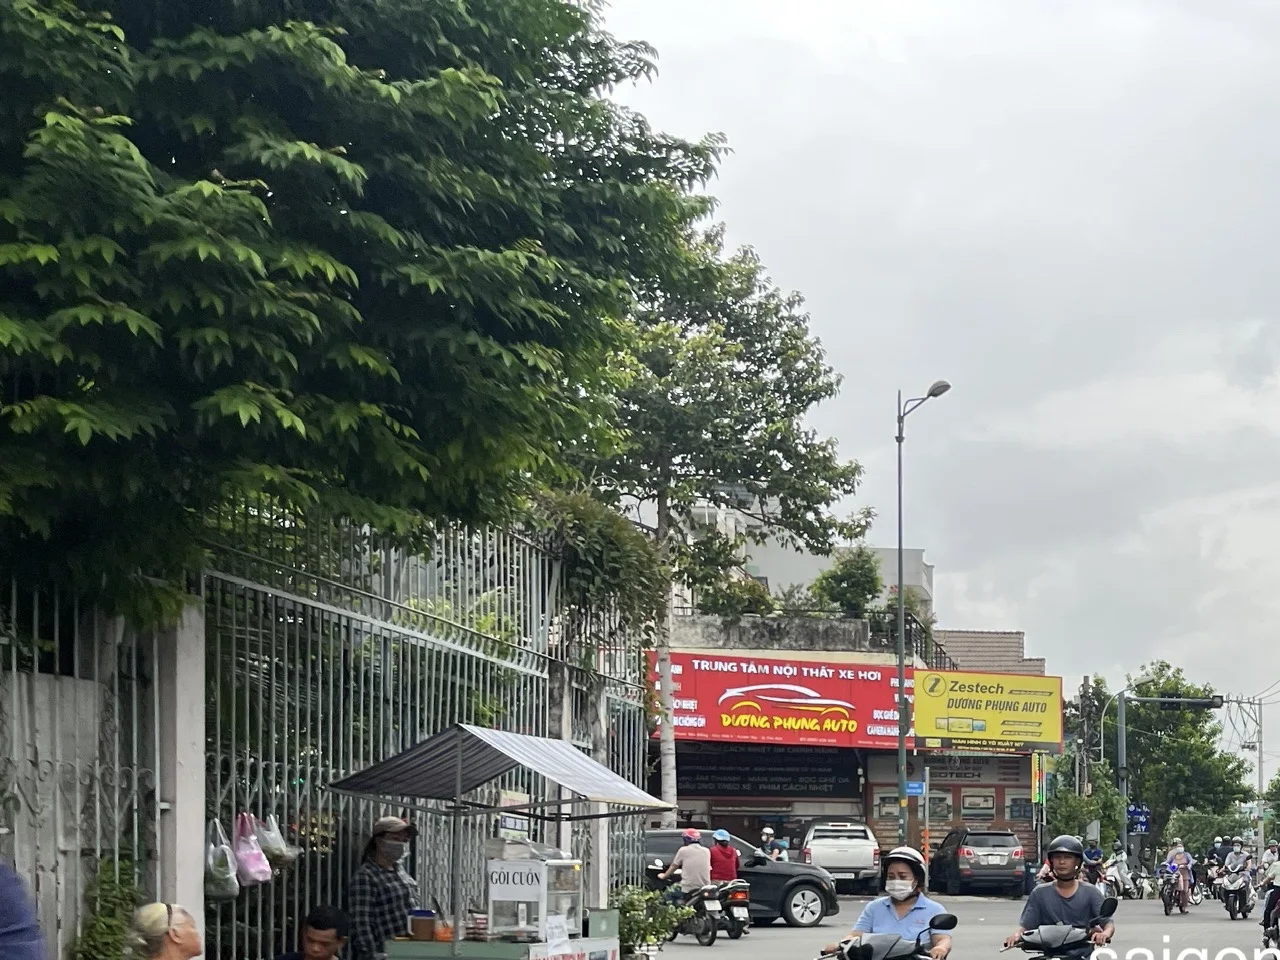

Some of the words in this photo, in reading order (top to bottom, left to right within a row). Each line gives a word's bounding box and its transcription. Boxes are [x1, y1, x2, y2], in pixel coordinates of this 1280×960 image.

[692, 659, 738, 673] TRUNG
[742, 661, 770, 675] TÂM
[773, 663, 798, 679] NỘI
[802, 665, 834, 679] THẤT
[838, 668, 854, 680] XE
[858, 670, 882, 682] HƠI
[950, 680, 1004, 695] Zestech
[947, 697, 981, 710] DƯƠNG
[984, 699, 1019, 714] PHỤNG
[1022, 702, 1047, 714] AUTO
[721, 712, 770, 729] DƯƠNG
[773, 715, 821, 733] PHỤNG
[823, 718, 858, 733] AUTO
